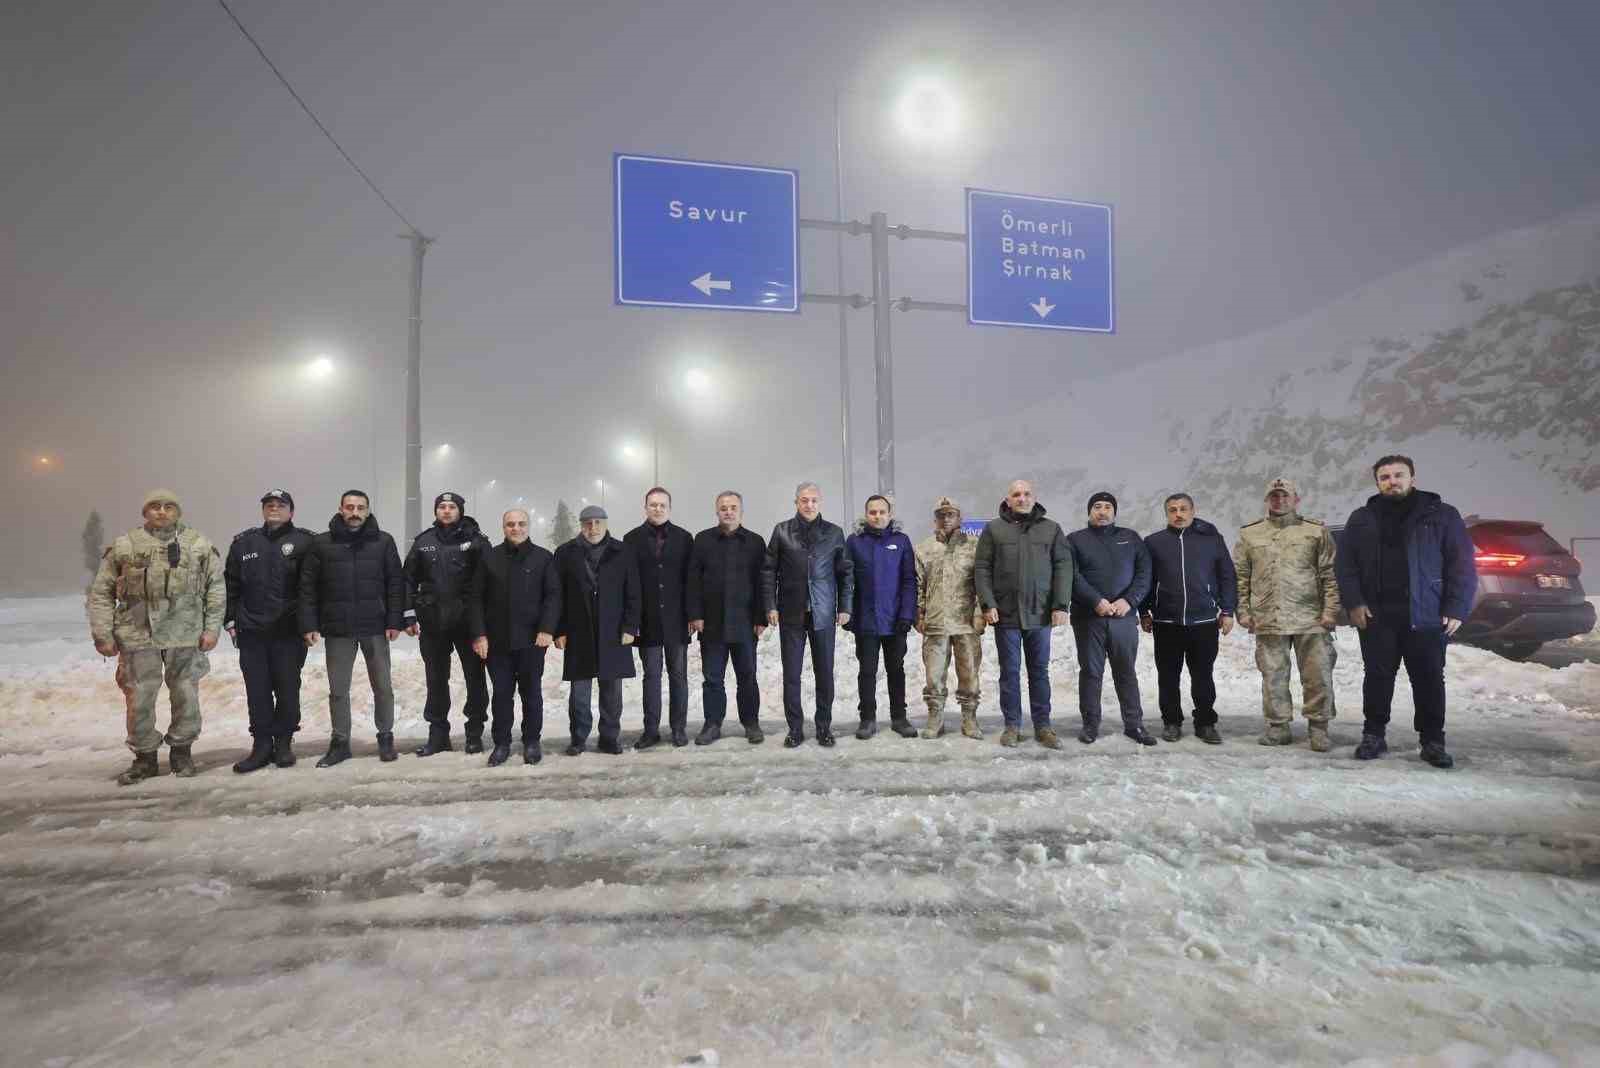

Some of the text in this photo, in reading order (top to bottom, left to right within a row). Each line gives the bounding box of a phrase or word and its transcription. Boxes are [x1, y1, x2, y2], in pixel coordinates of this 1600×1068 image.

[669, 200, 747, 224] Savur
[1001, 209, 1073, 236] Ömerli
[1001, 237, 1086, 260] Batman
[1002, 258, 1073, 281] Şırnak
